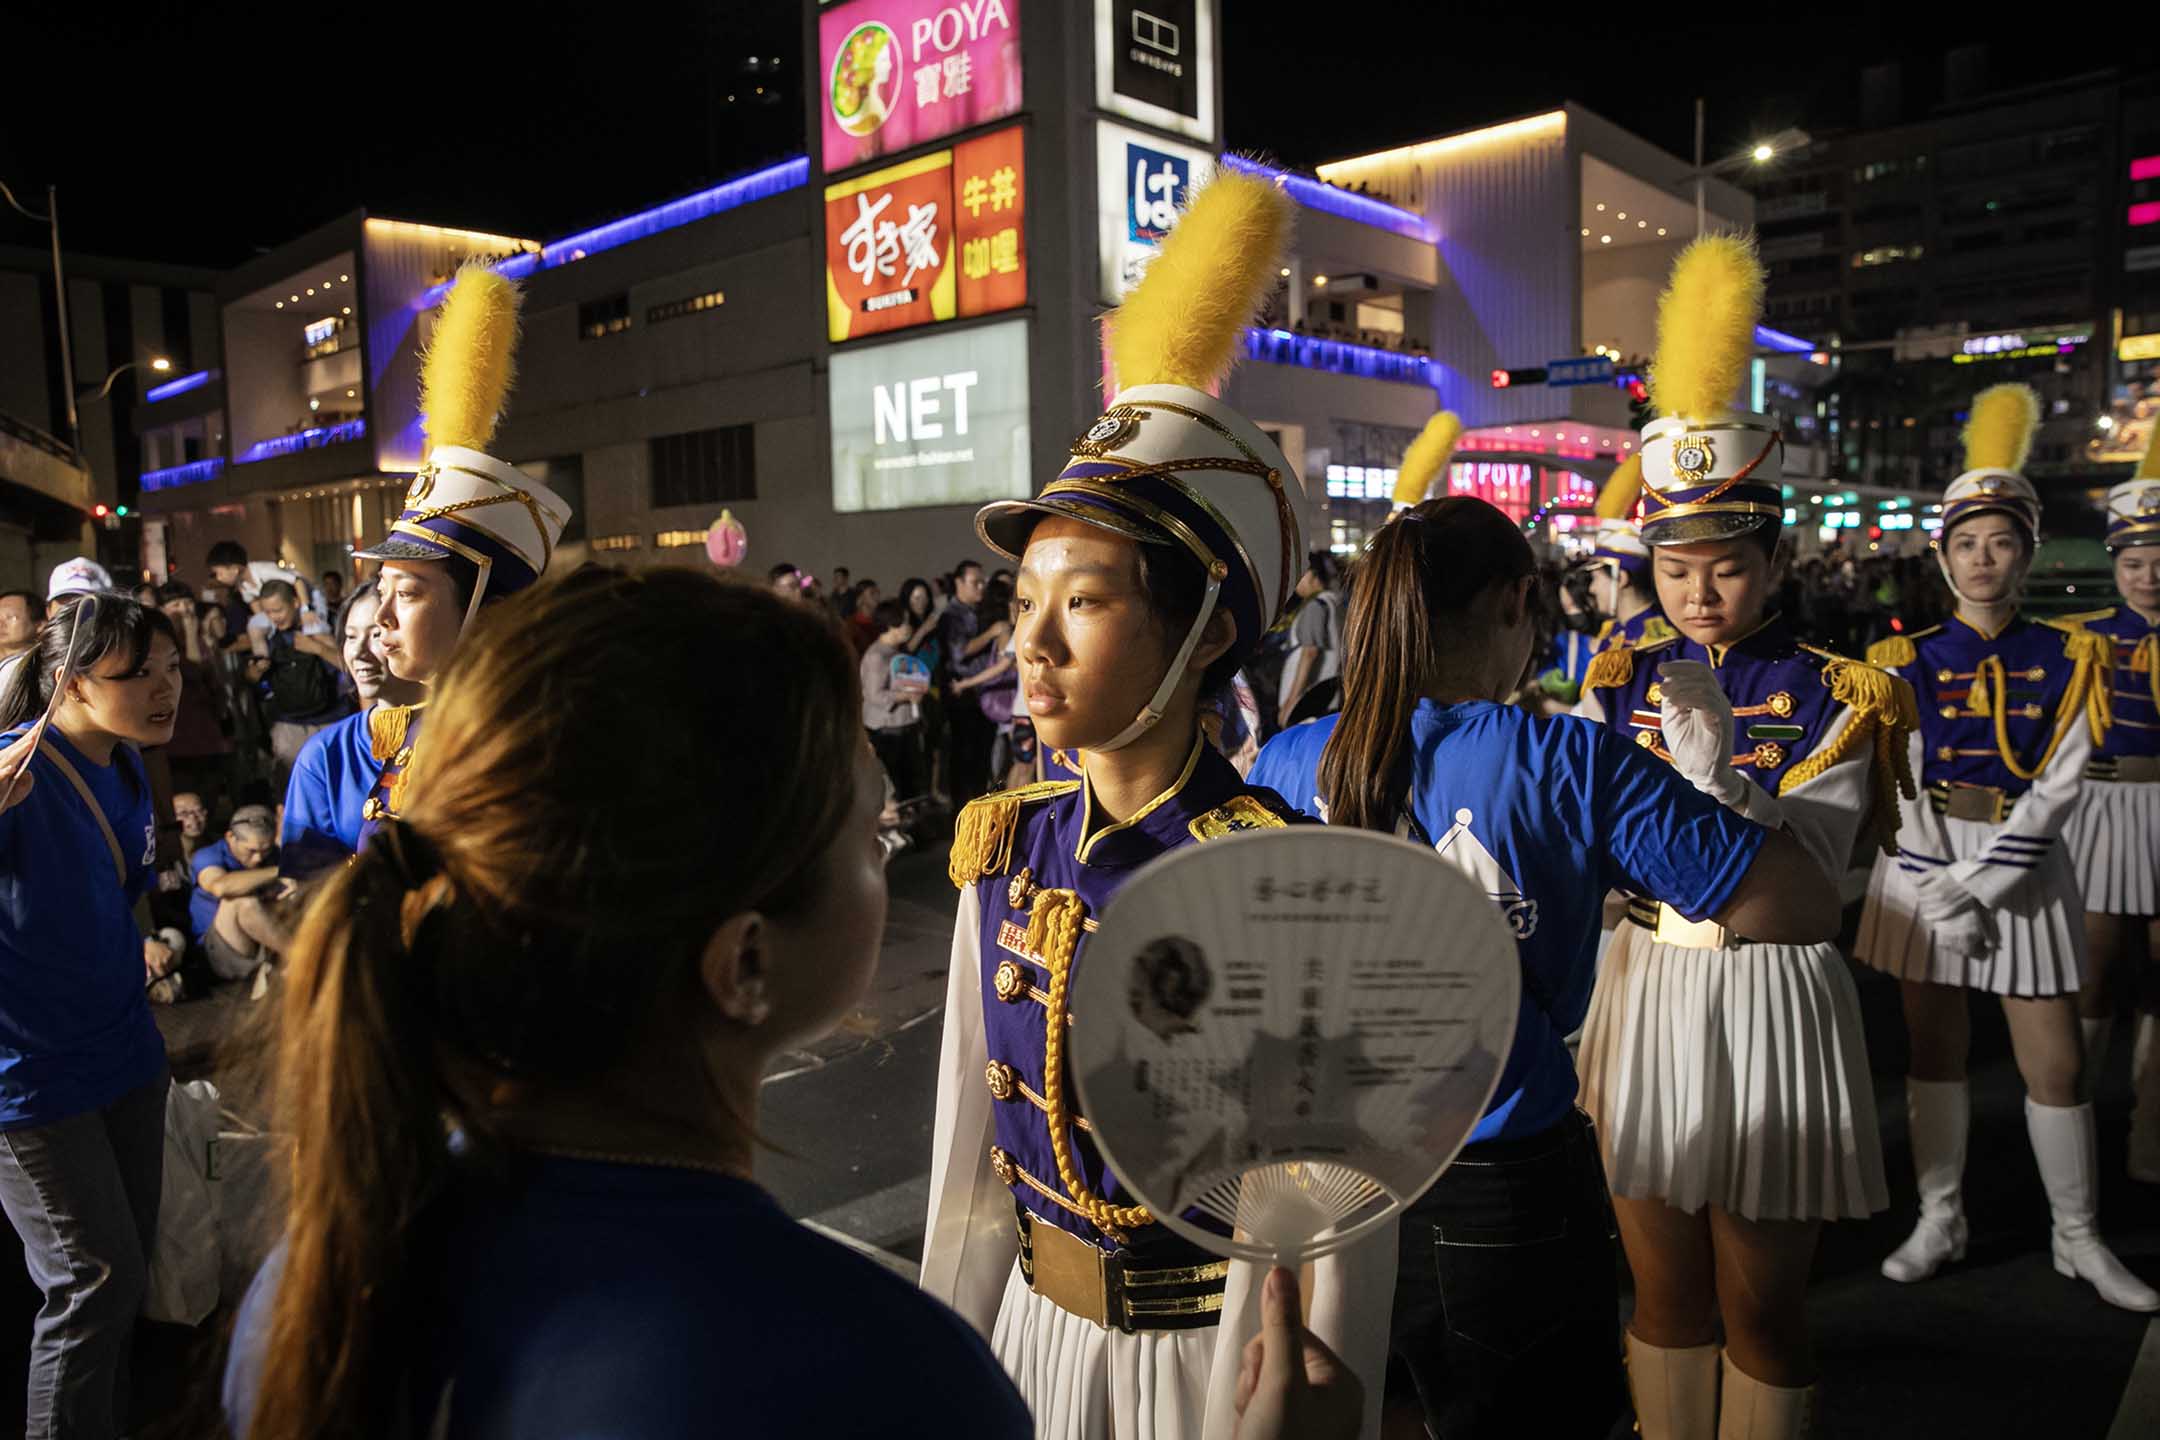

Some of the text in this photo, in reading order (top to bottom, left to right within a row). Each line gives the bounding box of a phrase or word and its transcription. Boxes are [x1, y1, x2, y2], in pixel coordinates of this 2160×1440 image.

[912, 0, 1010, 63] POYA
[840, 192, 940, 287] すき家
[873, 370, 978, 445] NET
